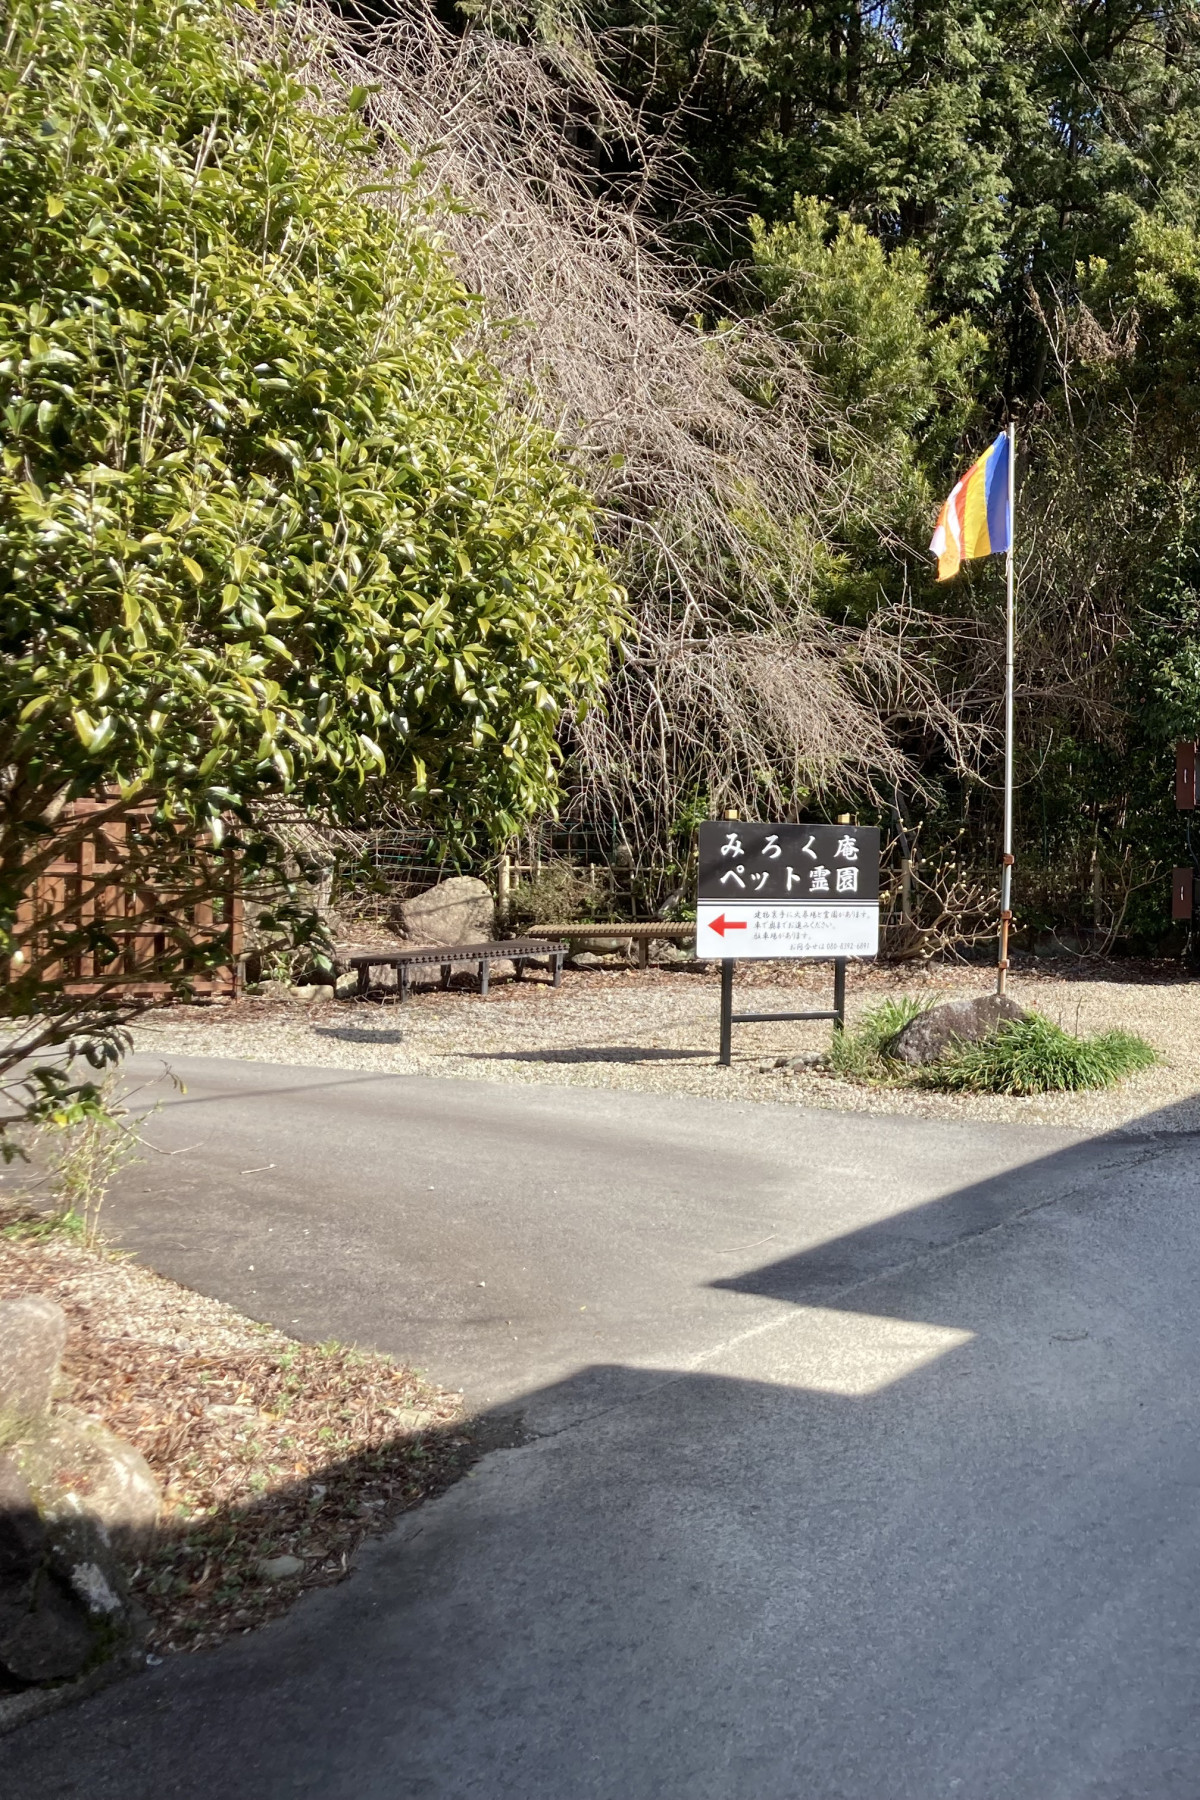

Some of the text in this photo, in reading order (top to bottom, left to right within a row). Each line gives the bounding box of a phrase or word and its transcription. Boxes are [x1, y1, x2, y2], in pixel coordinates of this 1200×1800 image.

[721, 833, 859, 861] みろく庵
[720, 865, 859, 892] ペット霊園
